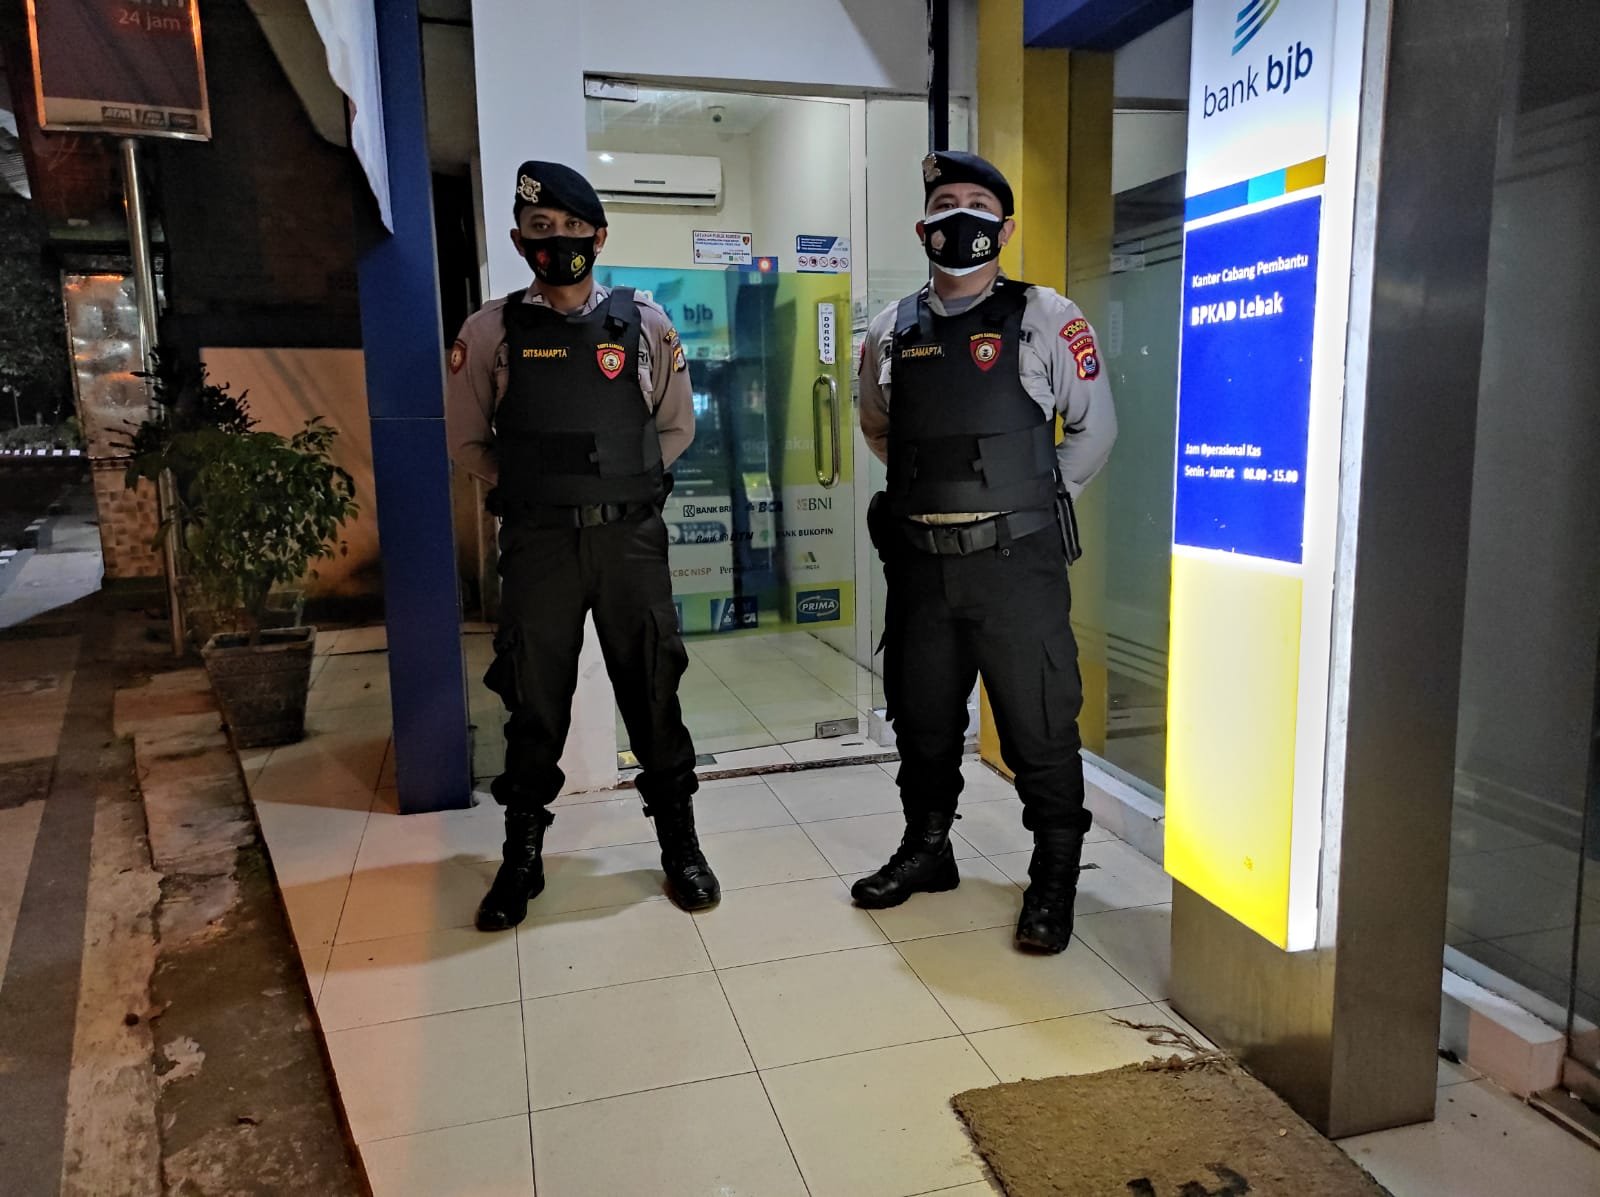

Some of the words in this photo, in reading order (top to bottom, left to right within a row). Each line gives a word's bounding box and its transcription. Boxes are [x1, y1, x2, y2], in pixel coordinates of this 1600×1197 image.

[118, 8, 141, 25] 24
[146, 13, 181, 32] jam
[1203, 65, 1259, 119] bank
[1266, 41, 1313, 94] bjb
[1192, 273, 1221, 288] Kantor
[1222, 266, 1256, 281] Cabang
[1257, 254, 1309, 275] Pembantu
[683, 304, 713, 324] bjb
[1191, 300, 1237, 326] BPKAD
[1240, 291, 1284, 319] Lebak
[823, 316, 831, 355] DORONG
[523, 348, 568, 359] DITSAMAPTA
[901, 345, 943, 358] DITSAMAPTA
[1185, 443, 1200, 455] Jam
[696, 506, 718, 515] BANK
[719, 505, 732, 514] BRI
[808, 497, 832, 511] BNI
[777, 530, 797, 538] ANK
[798, 528, 834, 537] BUKOPIN
[691, 568, 712, 576] NISP
[802, 601, 836, 611] PRIMA
